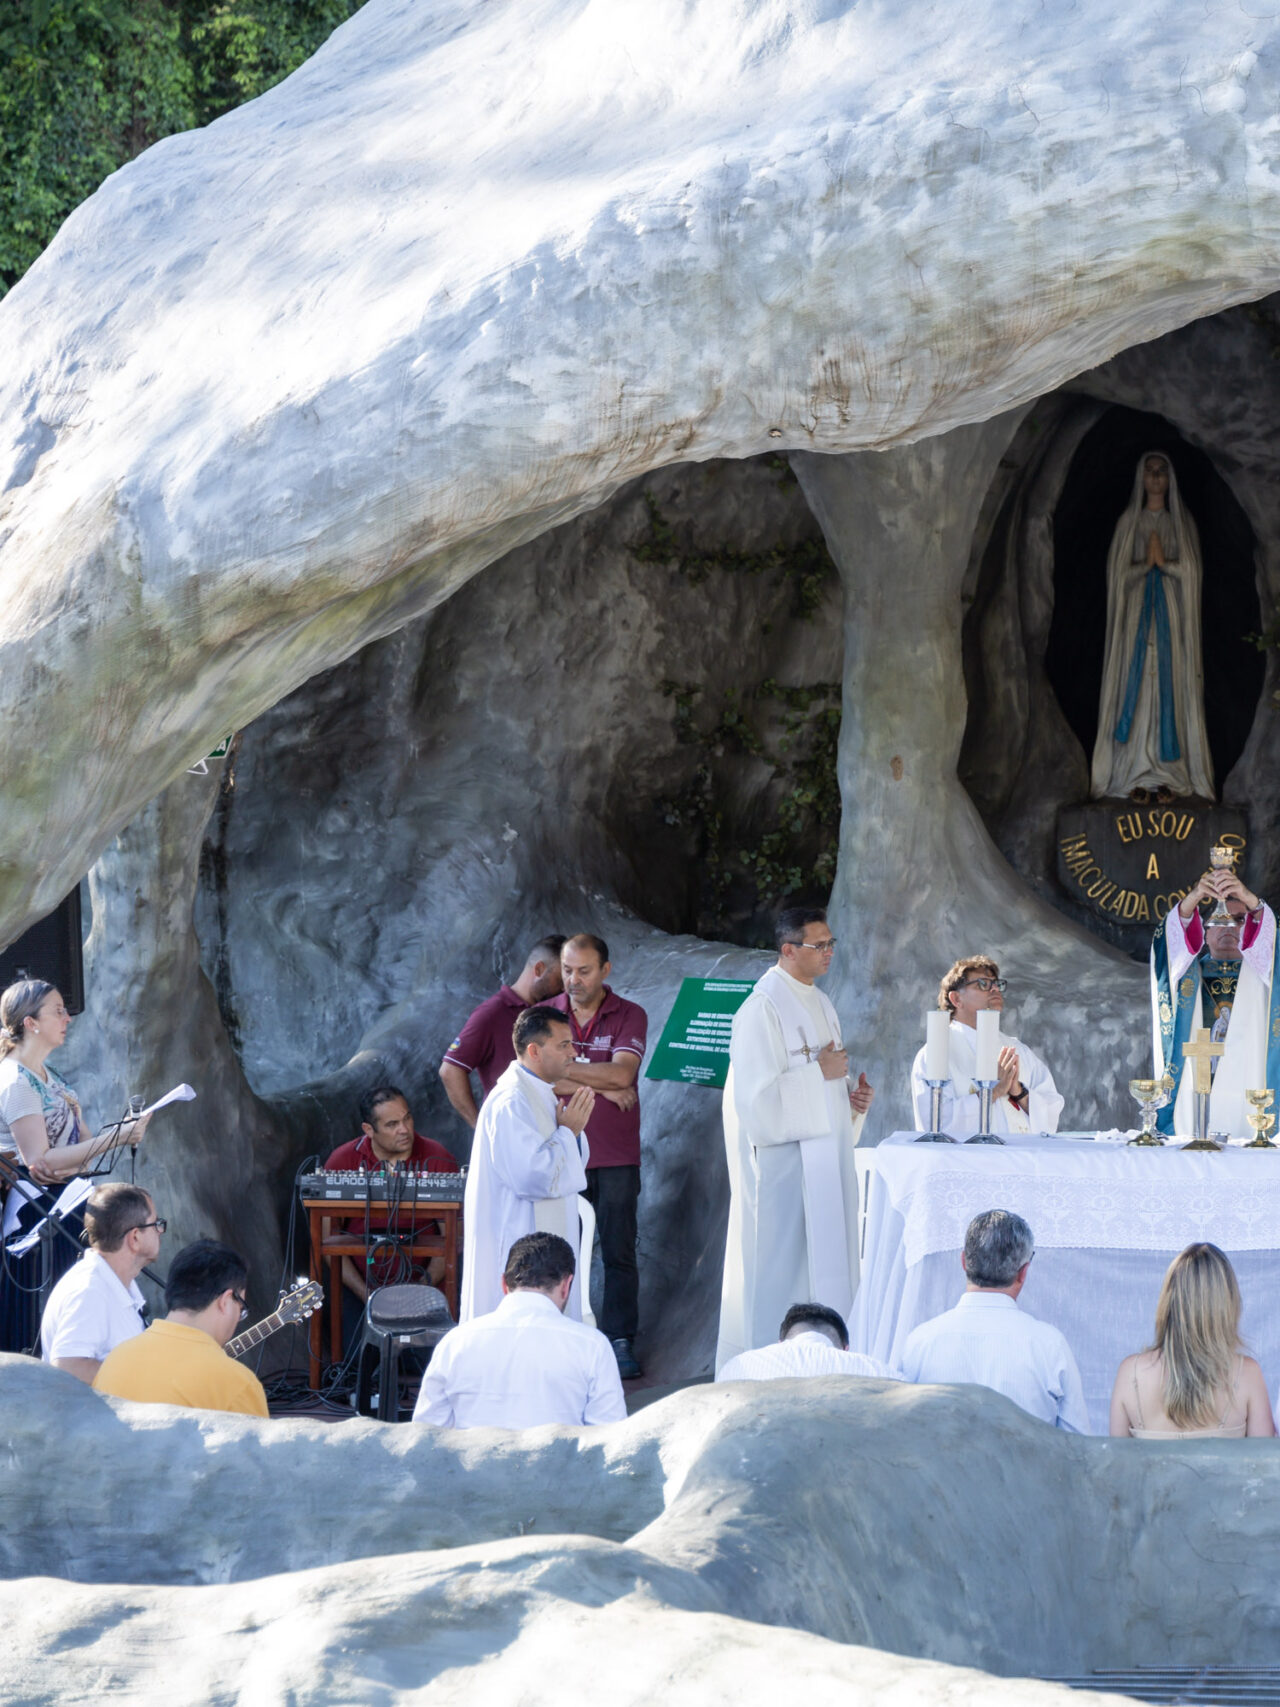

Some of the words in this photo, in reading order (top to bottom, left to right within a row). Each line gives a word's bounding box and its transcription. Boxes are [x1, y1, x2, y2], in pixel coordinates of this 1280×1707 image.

[1115, 812, 1144, 843] EU
[1147, 811, 1195, 841] SOU
[1060, 833, 1150, 921] IMACULADA
[1146, 853, 1160, 880] A
